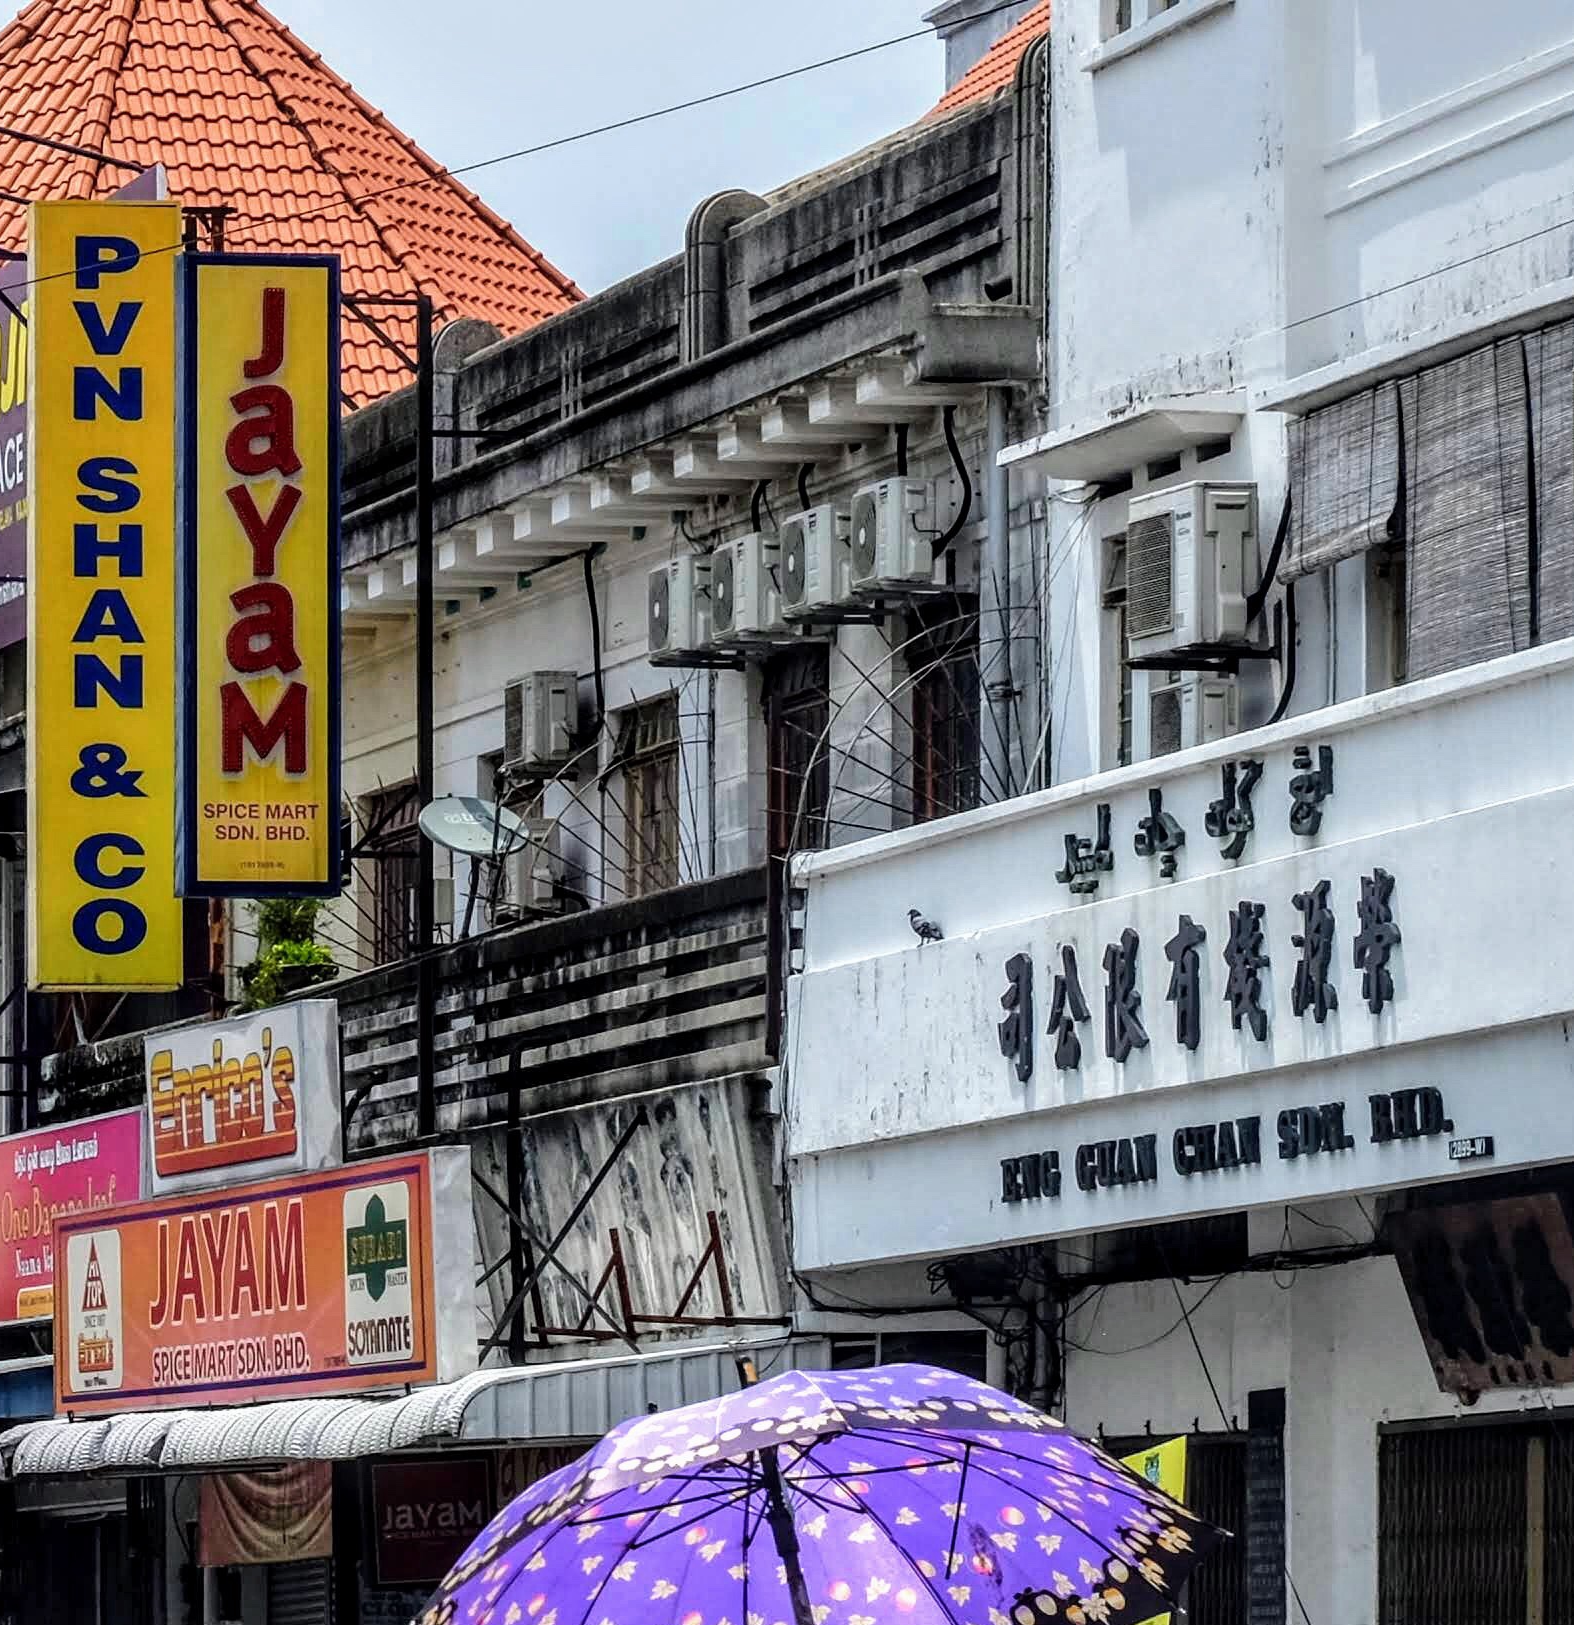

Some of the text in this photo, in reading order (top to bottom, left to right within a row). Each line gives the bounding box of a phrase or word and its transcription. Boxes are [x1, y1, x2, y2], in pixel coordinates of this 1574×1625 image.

[72, 235, 144, 422] PVN
[71, 455, 147, 710] SHAN
[69, 742, 149, 800] &
[203, 803, 319, 820] SPICE MART
[215, 824, 310, 841] SDN. BHD.
[71, 832, 148, 956] CO
[1000, 1085, 1454, 1204] ENG GUAN CHAN SDN. BHD.
[2, 1191, 30, 1243] One
[149, 1199, 309, 1330] JAYAM
[85, 1282, 104, 1308] TOP
[153, 1333, 311, 1384] SPICE MART SDN. BHD.
[347, 1314, 412, 1359] SOYAMATE
